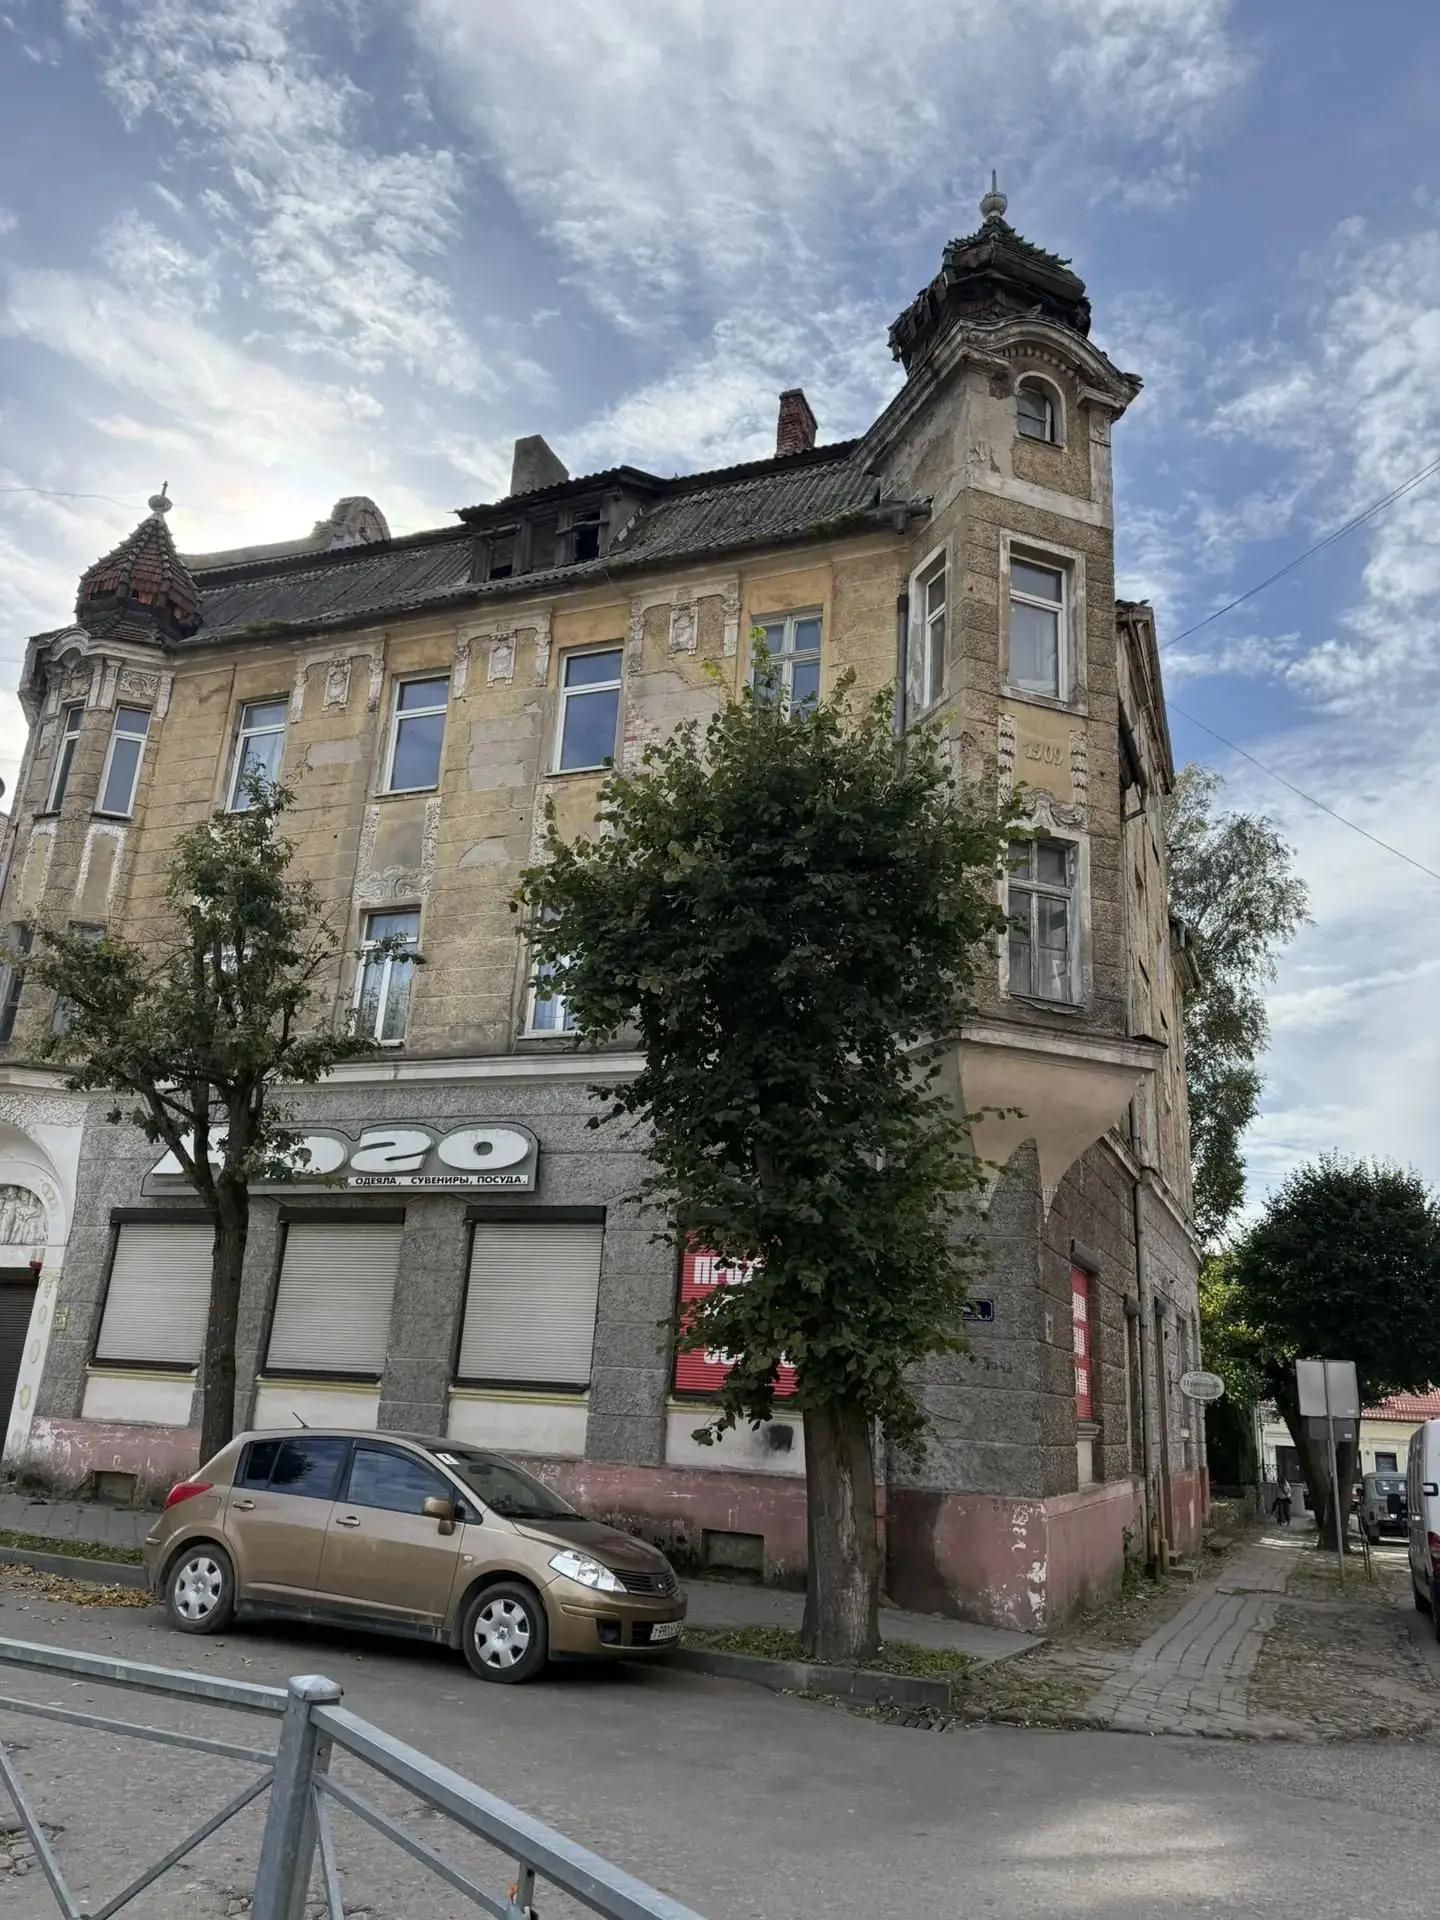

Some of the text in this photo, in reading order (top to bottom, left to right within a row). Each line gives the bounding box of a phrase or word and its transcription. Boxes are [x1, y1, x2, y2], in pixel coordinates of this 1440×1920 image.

[355, 1175, 526, 1186] ОДЕЯЛА, СУВЕНИРЫ, ПОСУДА.
